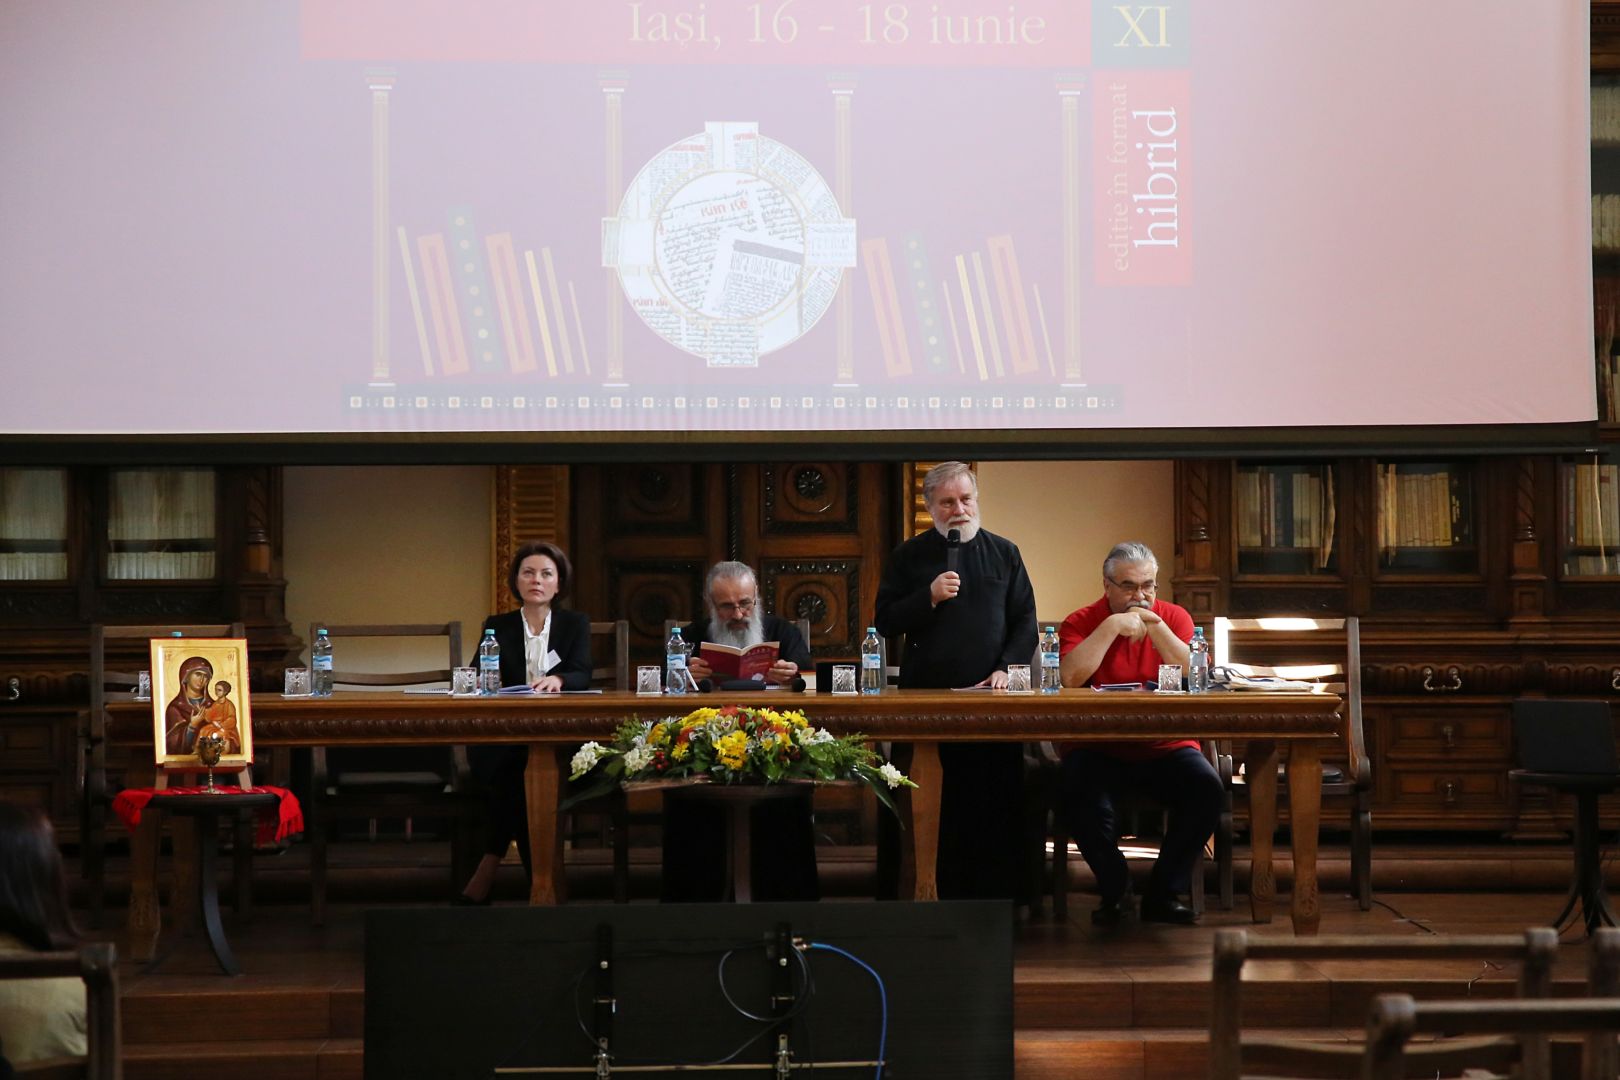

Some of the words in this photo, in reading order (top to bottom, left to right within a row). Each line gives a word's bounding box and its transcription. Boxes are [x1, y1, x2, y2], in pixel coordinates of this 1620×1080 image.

[748, 0, 799, 44] 16
[857, 3, 910, 45] 18
[929, 4, 1046, 45] iunie
[1112, 6, 1171, 48] XI
[1106, 83, 1128, 163] format
[1107, 172, 1128, 195] în
[1132, 106, 1178, 249] hibrid
